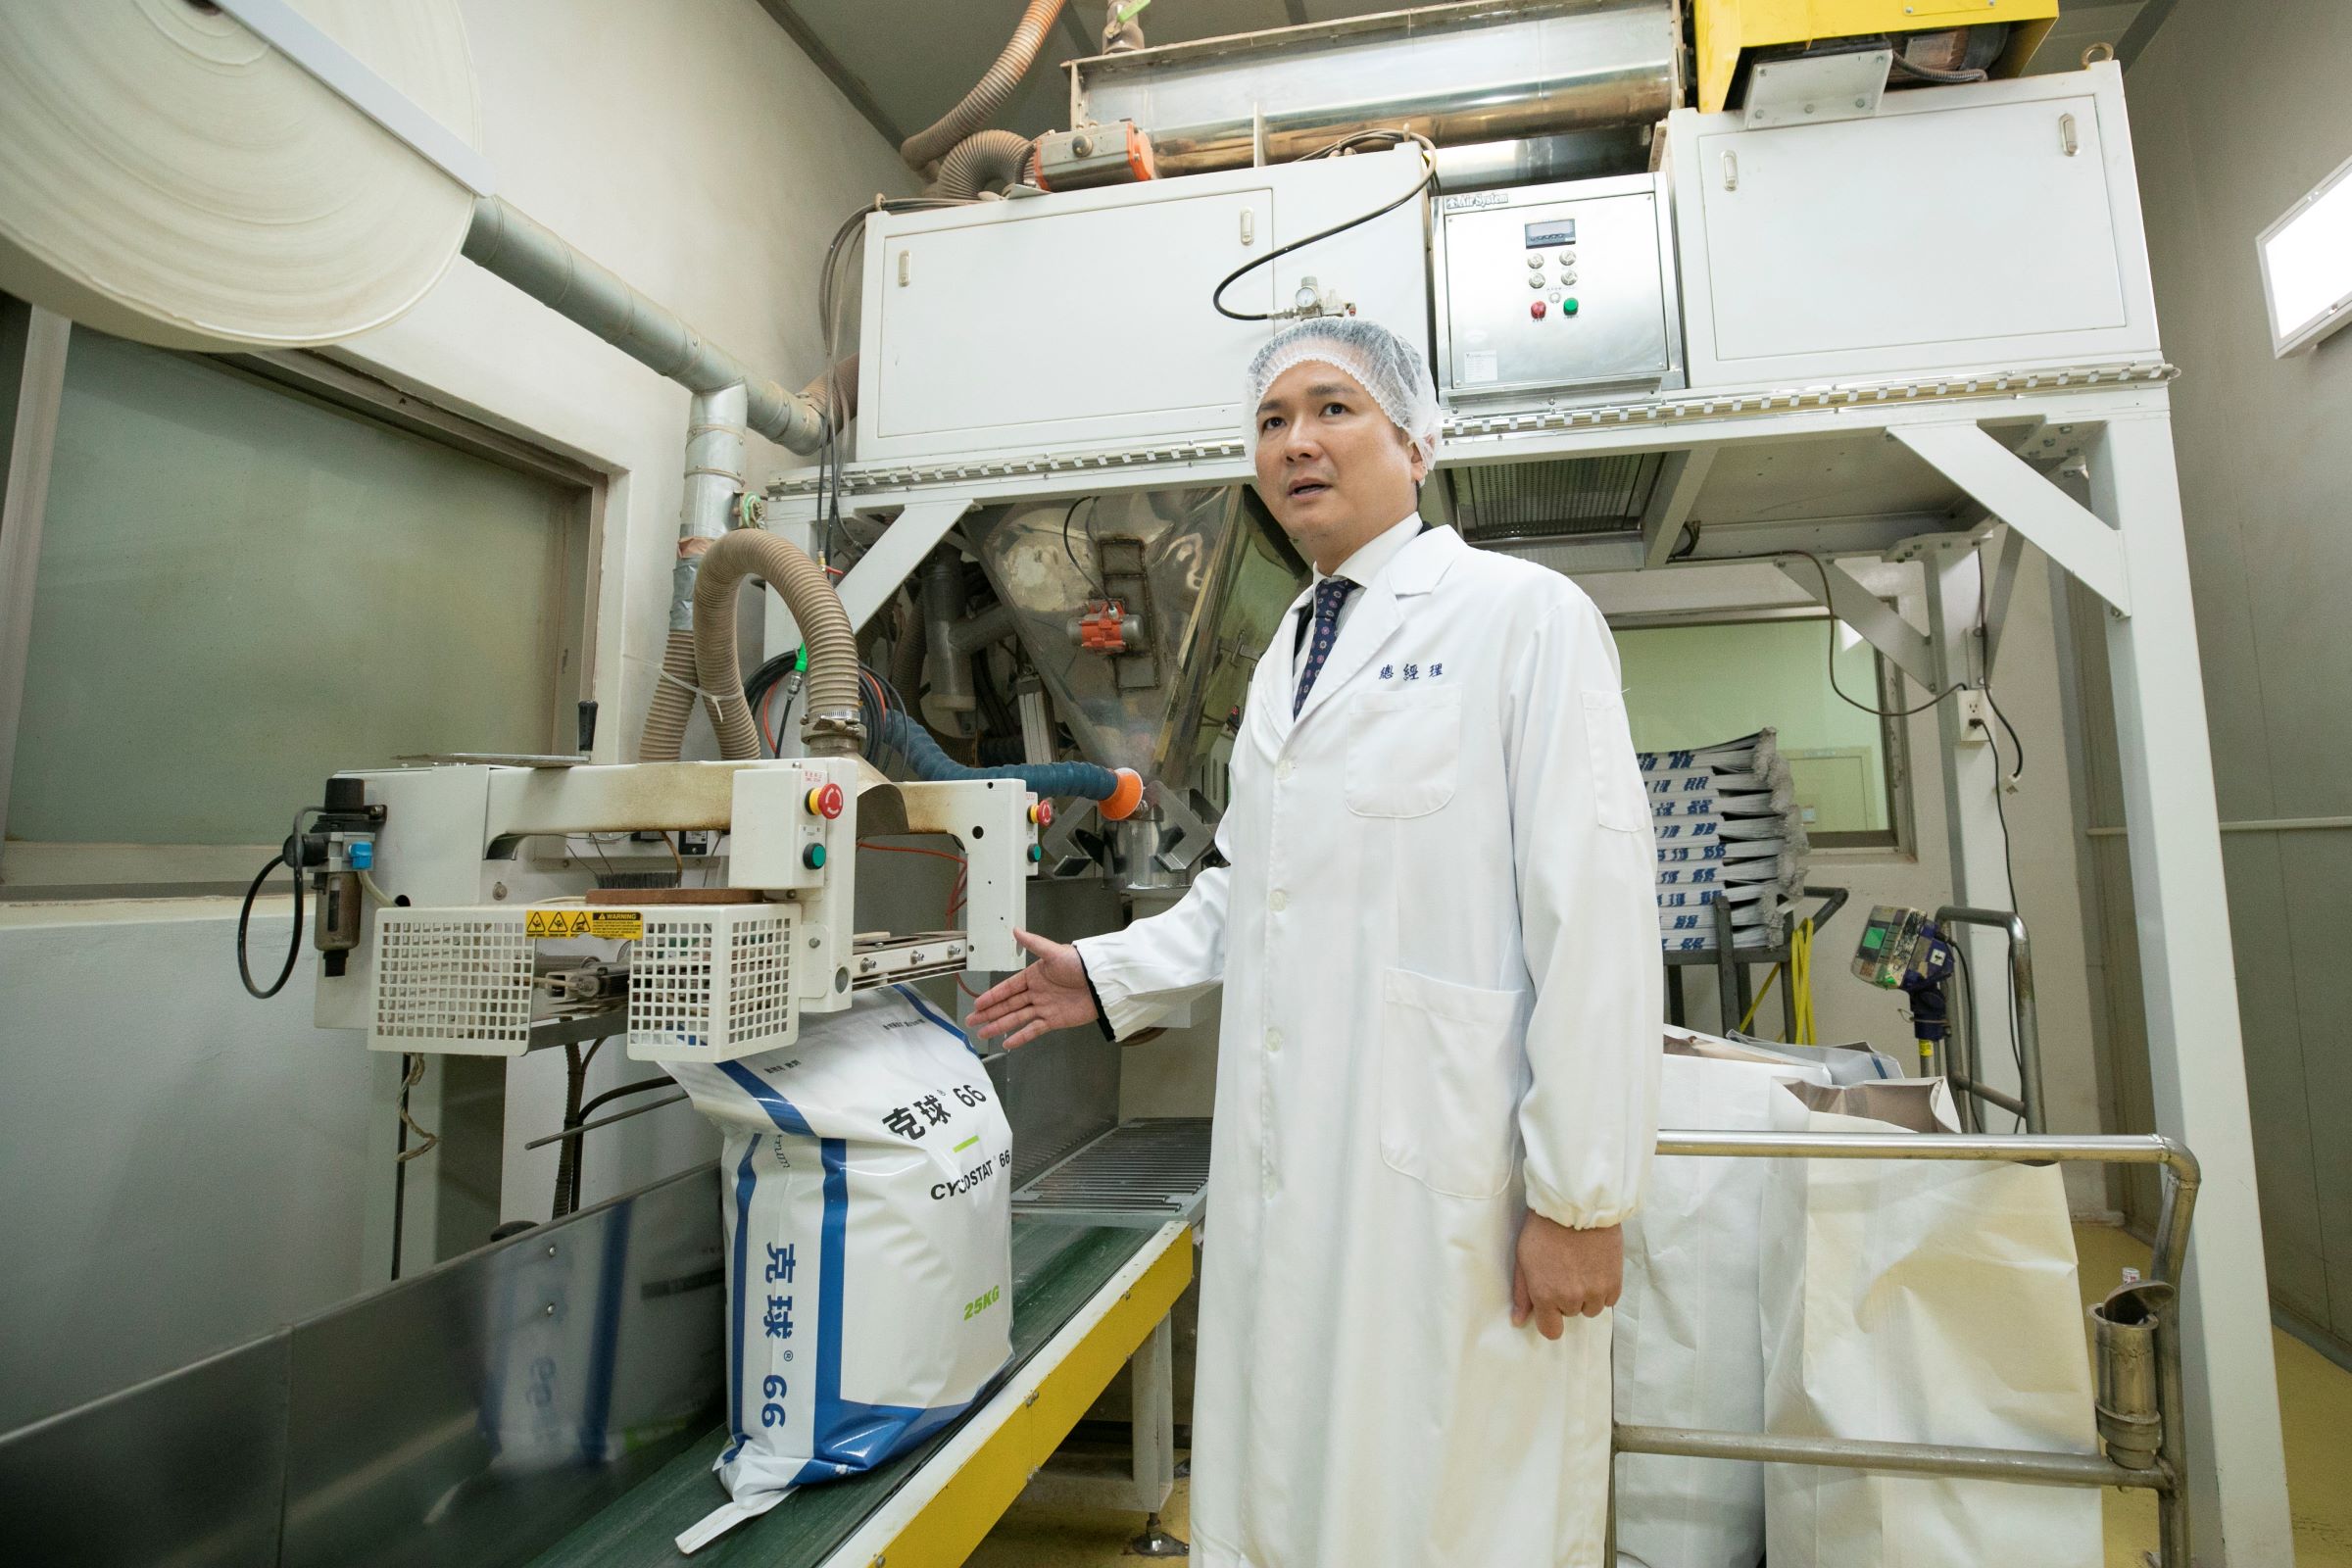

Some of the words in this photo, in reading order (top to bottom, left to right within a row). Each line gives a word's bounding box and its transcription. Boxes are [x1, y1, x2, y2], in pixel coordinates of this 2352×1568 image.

[1379, 662, 1443, 681] 總經理
[953, 1084, 987, 1107] 66
[999, 1149, 1010, 1168] 66
[963, 1285, 1000, 1321] 25KG
[761, 1374, 788, 1428] 66
